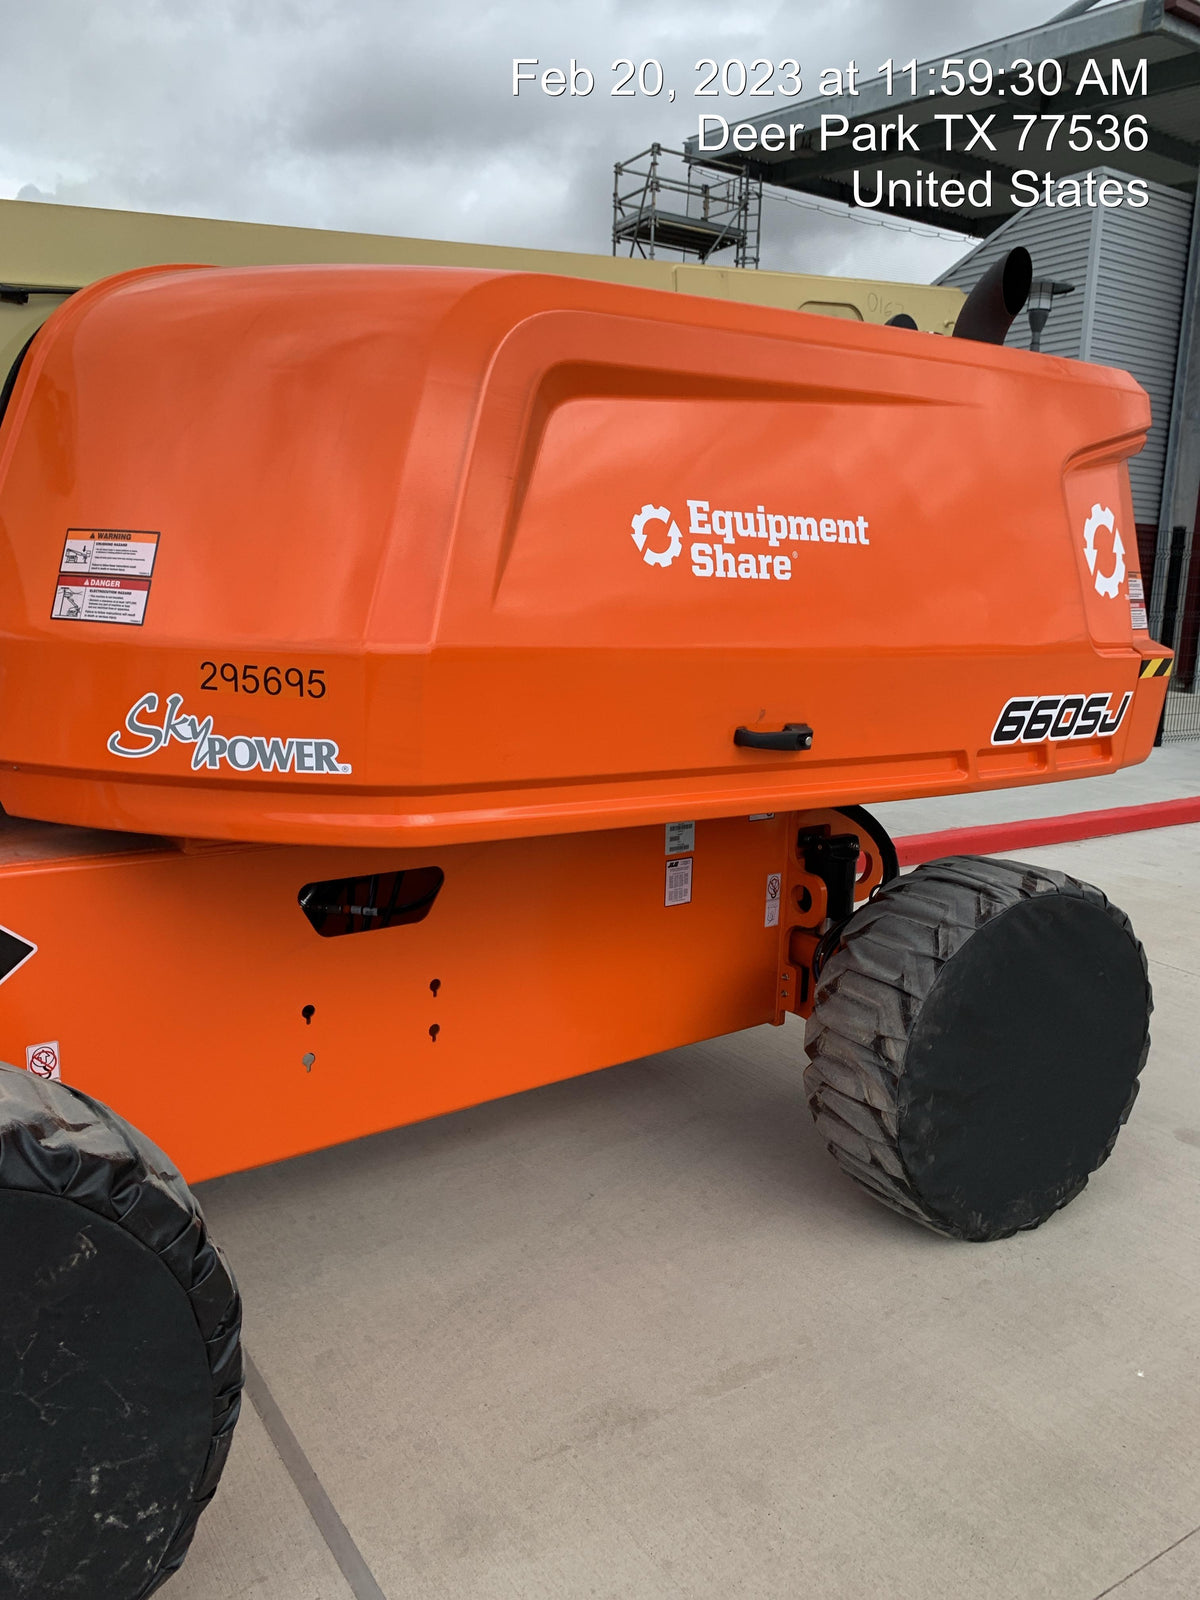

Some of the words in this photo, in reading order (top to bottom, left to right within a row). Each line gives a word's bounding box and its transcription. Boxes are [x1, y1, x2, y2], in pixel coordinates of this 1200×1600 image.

[97, 532, 132, 541] WARNING
[687, 499, 870, 547] Equipment
[690, 542, 792, 581] Share
[90, 579, 121, 588] DANGER
[199, 661, 326, 699] 295695
[992, 693, 1131, 743] 660SJ
